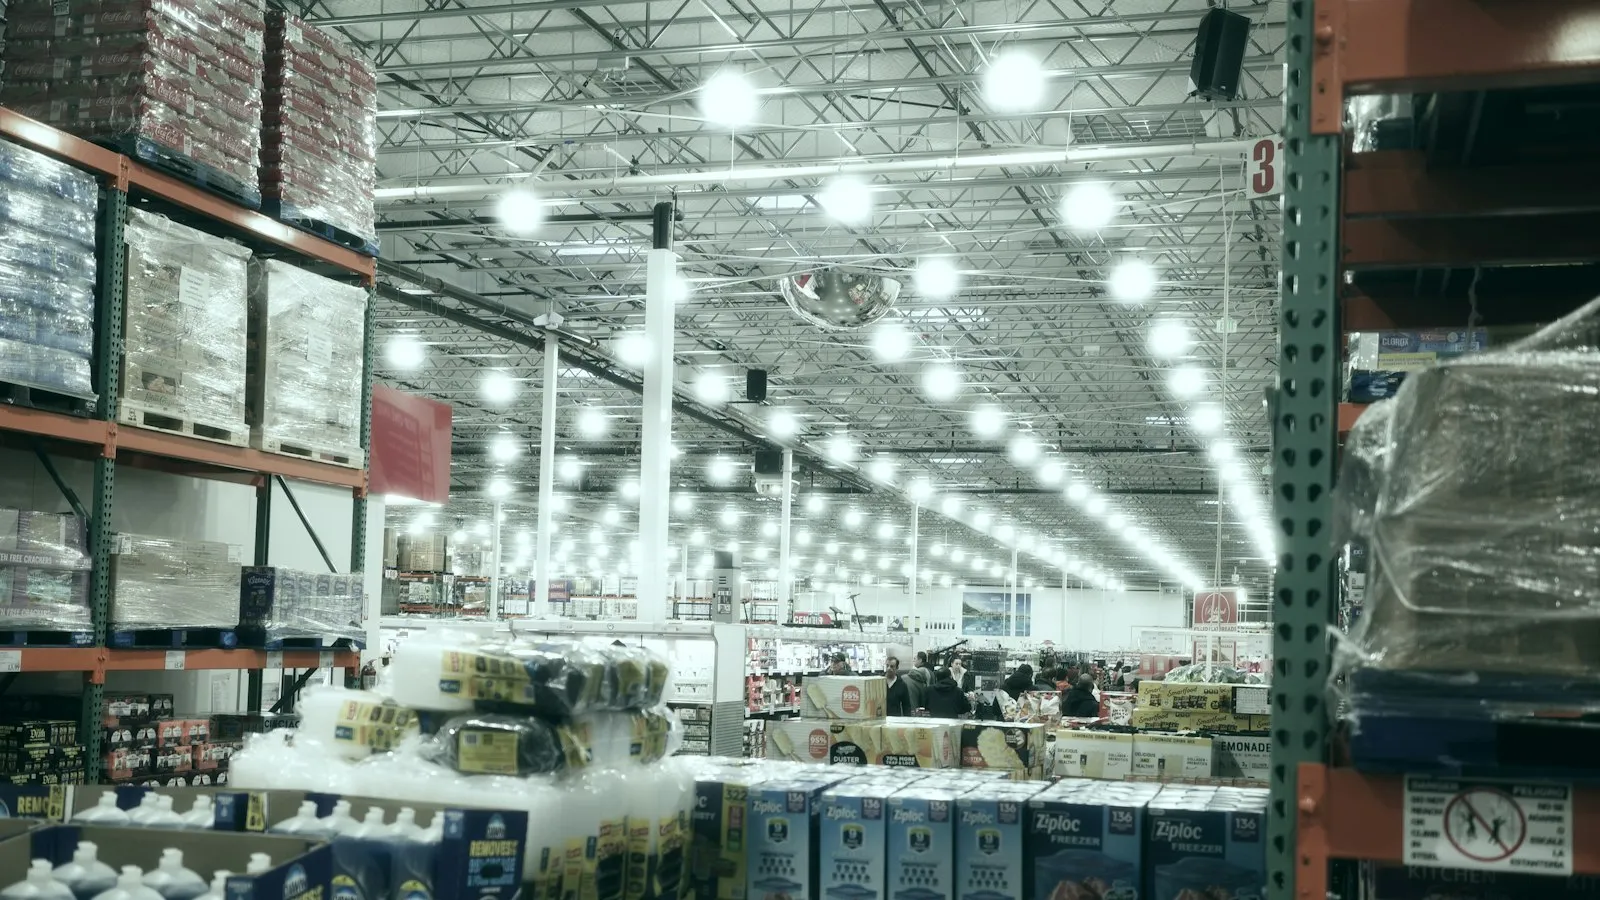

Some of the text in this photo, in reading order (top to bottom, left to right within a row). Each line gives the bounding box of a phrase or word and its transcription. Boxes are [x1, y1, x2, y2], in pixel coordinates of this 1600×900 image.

[1382, 337, 1409, 347] CLOROX
[9, 554, 23, 563] FREE
[1167, 686, 1197, 697] Smartfood
[1138, 713, 1168, 723] Smartfood
[1196, 715, 1227, 725] Smartfood
[726, 789, 748, 801] 322
[788, 792, 804, 802] 136
[1513, 786, 1565, 796] PELIGRO
[753, 800, 783, 815] Ziploc
[863, 798, 880, 808] 136
[930, 801, 947, 811] 136
[999, 803, 1016, 813] 136
[827, 806, 858, 820] Ziploc
[894, 810, 924, 823] Ziploc
[962, 811, 993, 824] Ziploc
[1112, 810, 1133, 823] 136
[1036, 814, 1081, 834] Ziploc
[1235, 817, 1256, 830] 136
[1157, 821, 1203, 840] Ziploc
[1051, 834, 1100, 847] FREEZER
[1172, 842, 1223, 855] FREEZER
[1407, 864, 1497, 884] KITCHEN
